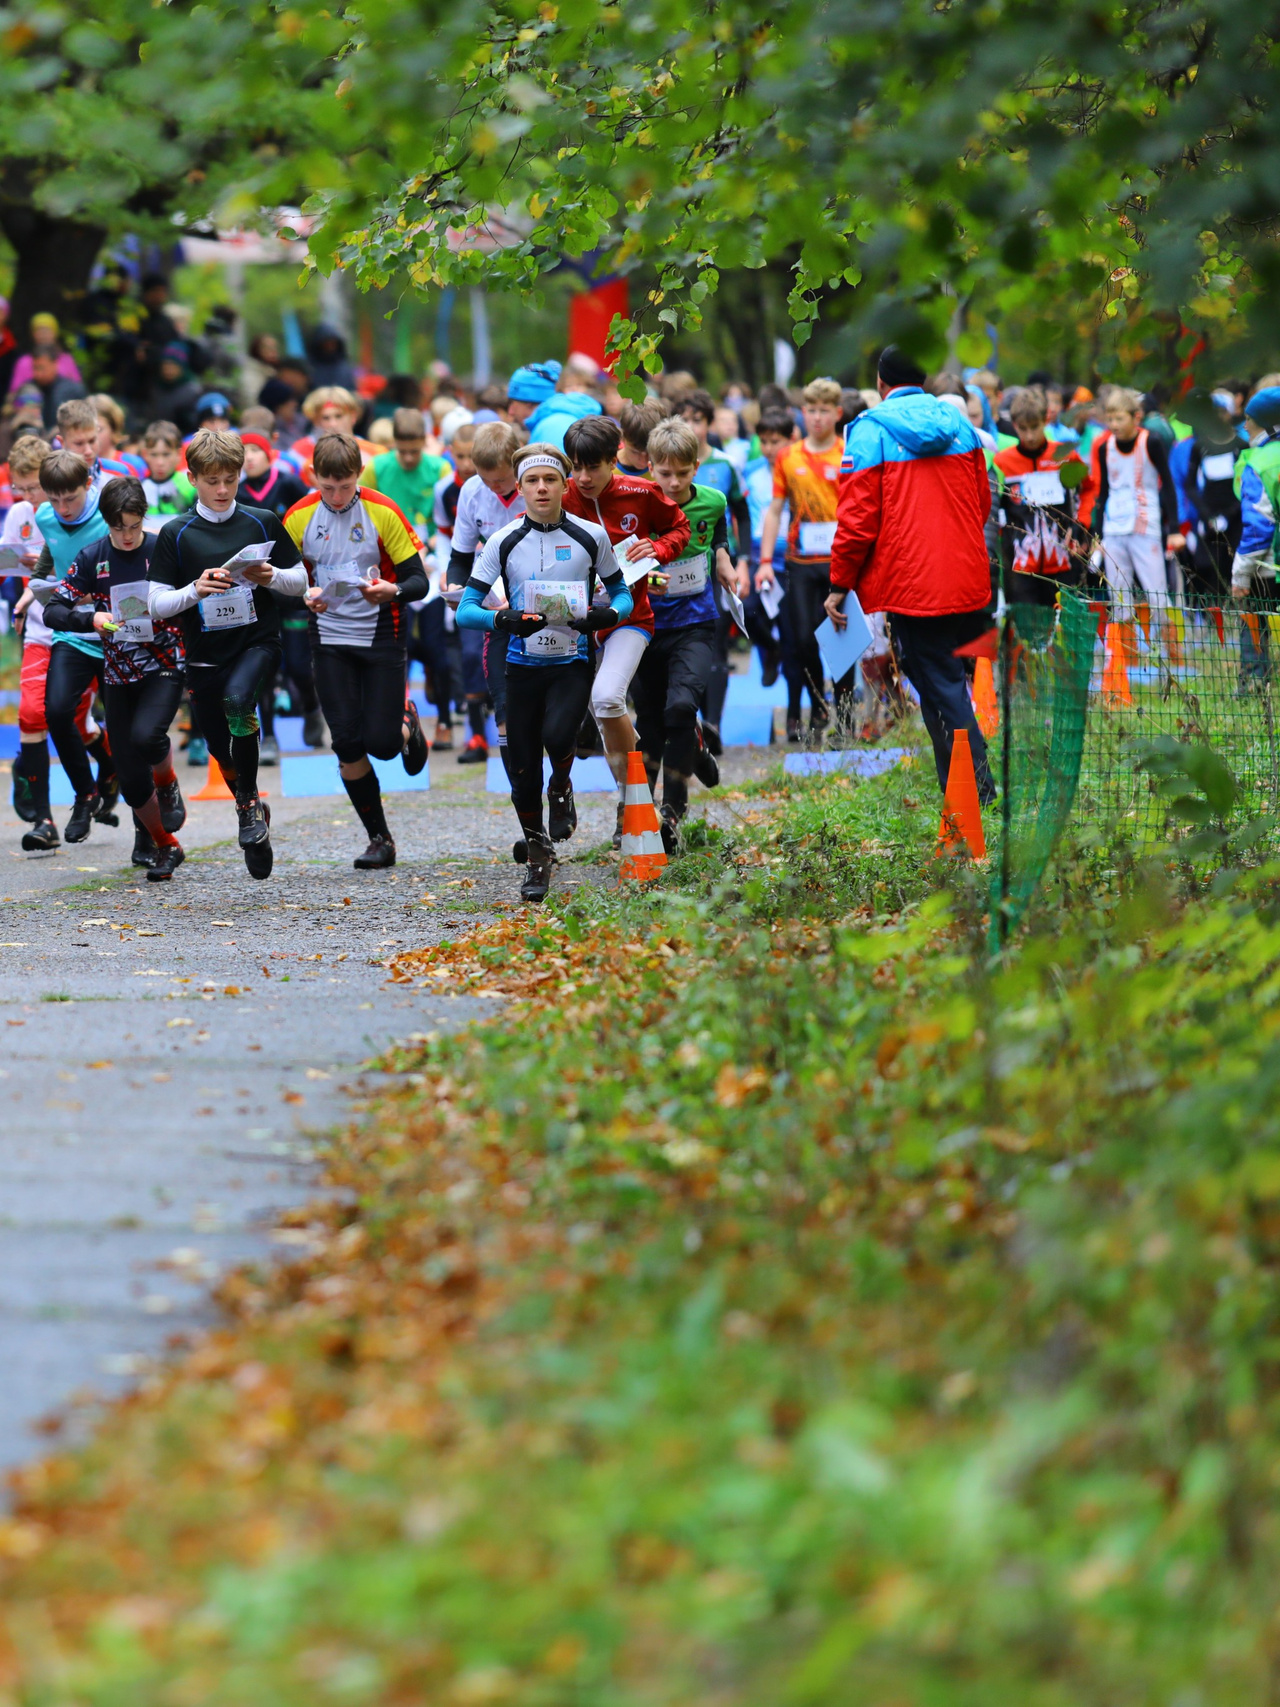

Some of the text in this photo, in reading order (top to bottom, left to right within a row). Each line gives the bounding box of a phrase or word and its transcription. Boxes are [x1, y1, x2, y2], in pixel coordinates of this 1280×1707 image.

[523, 456, 560, 468] noname
[678, 572, 696, 584] 236
[215, 606, 235, 617] 229
[124, 625, 141, 634] 238
[537, 636, 556, 646] 226
